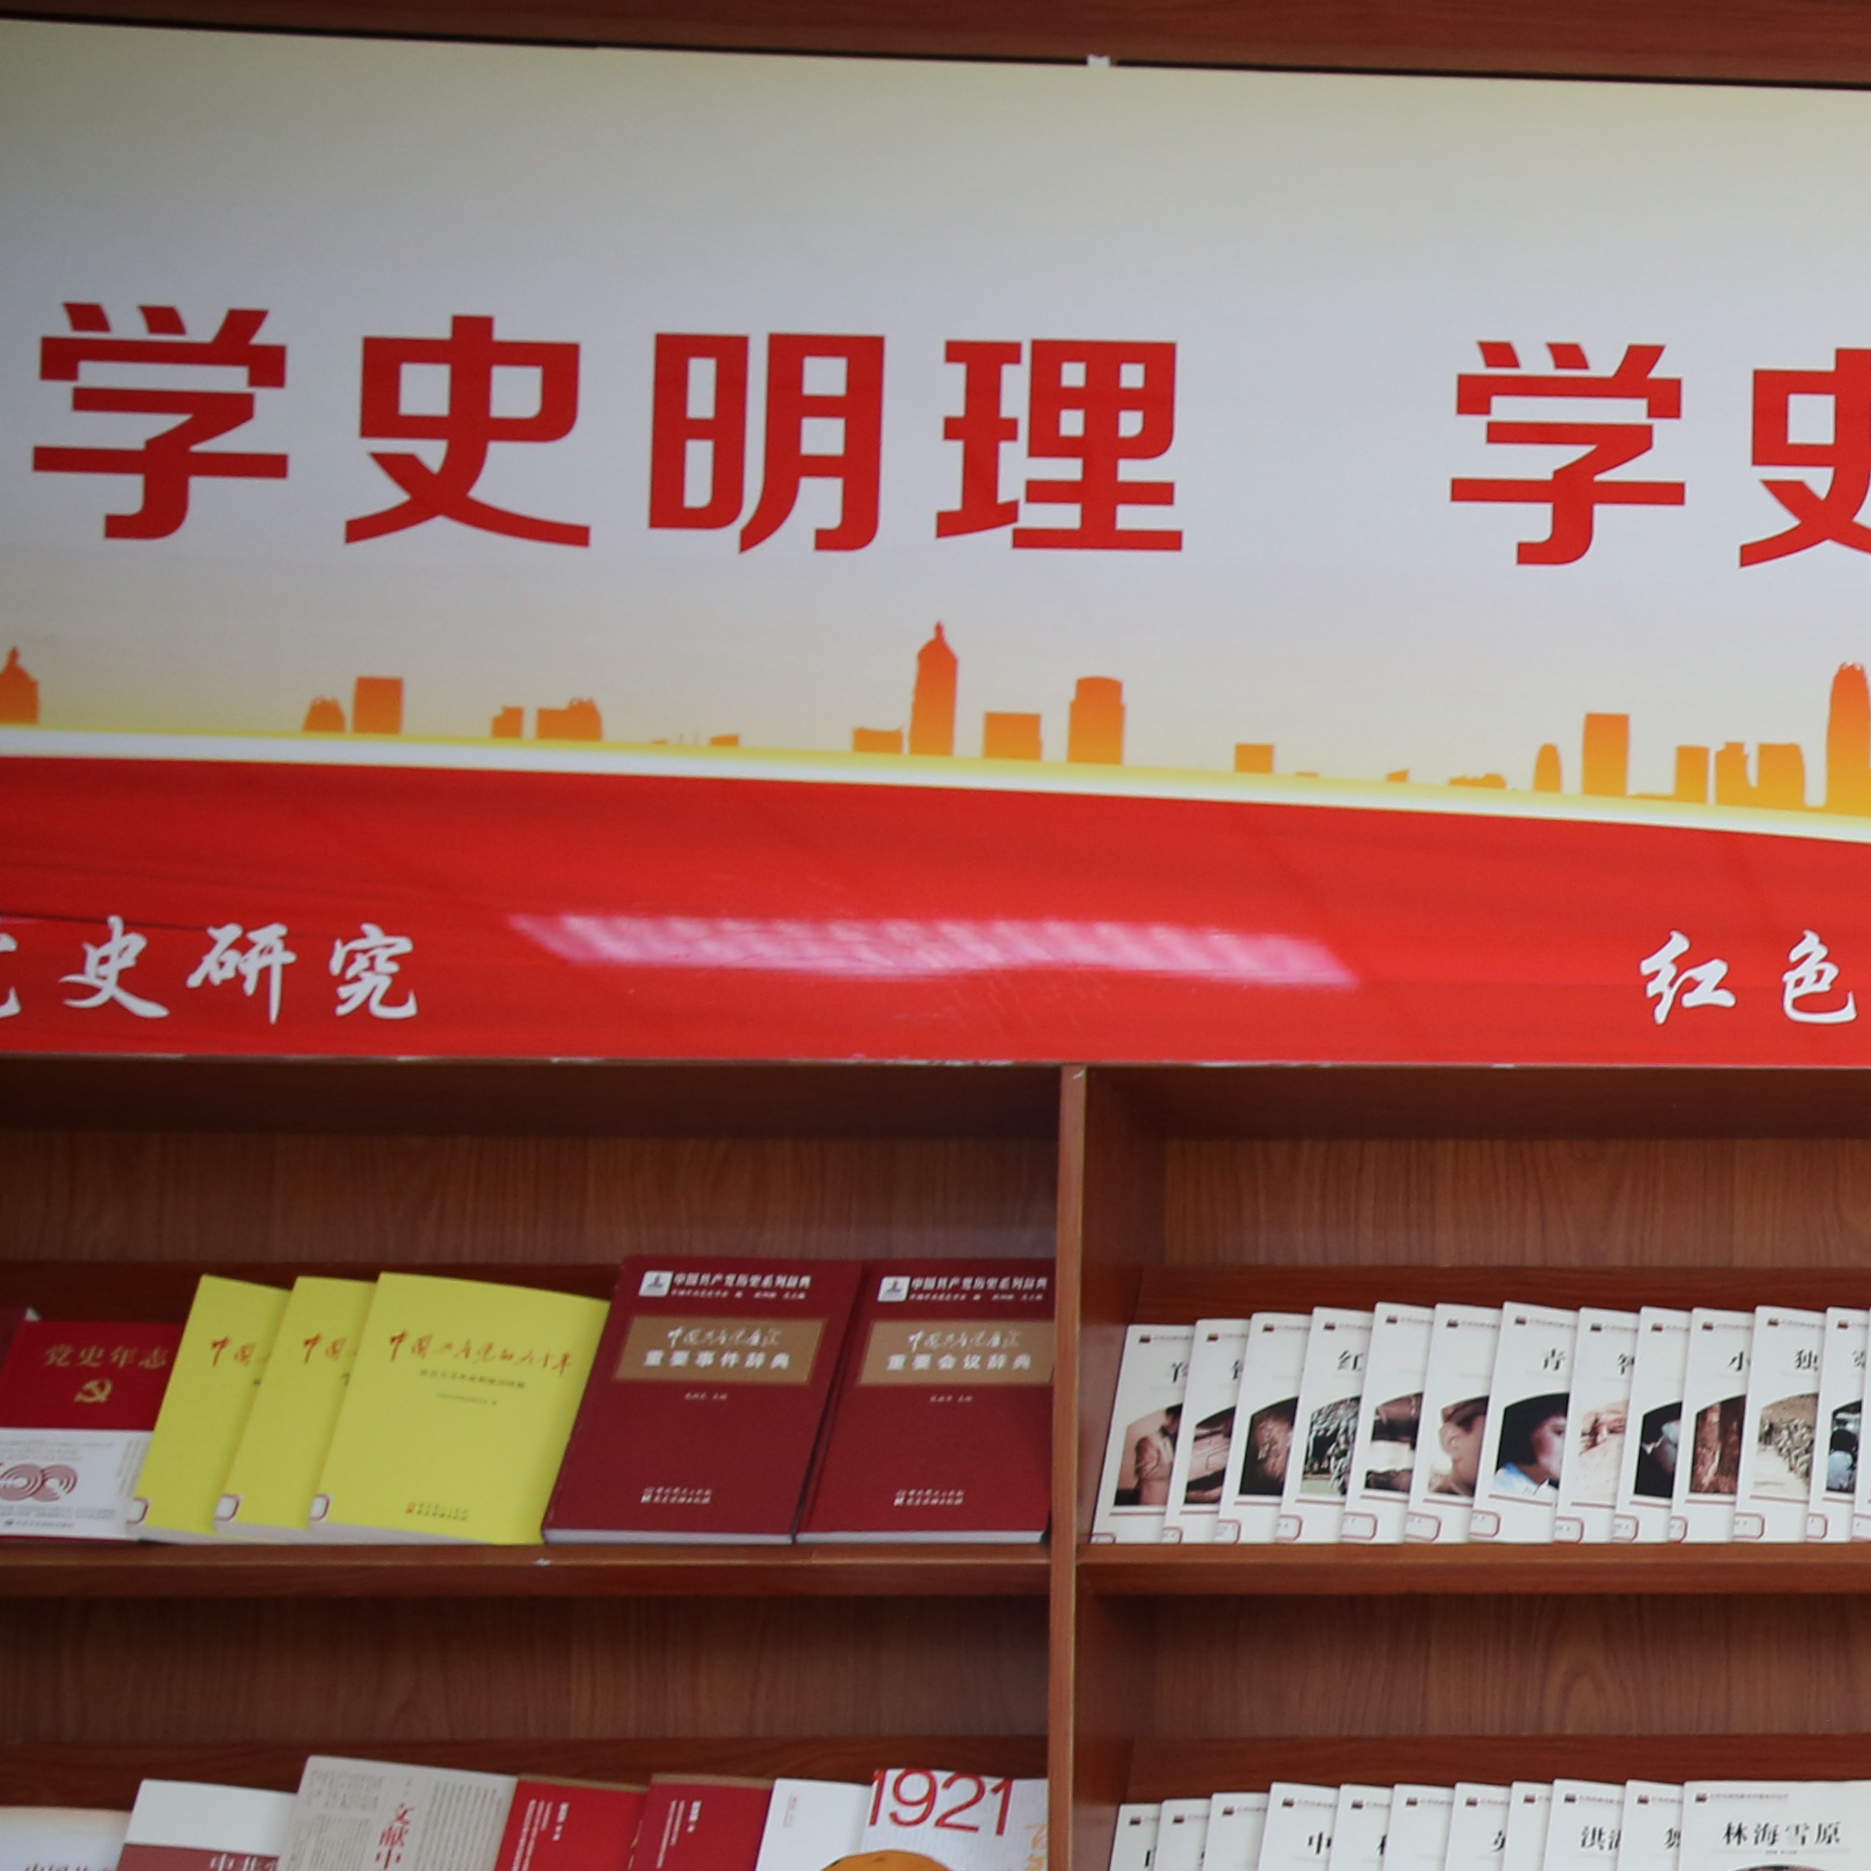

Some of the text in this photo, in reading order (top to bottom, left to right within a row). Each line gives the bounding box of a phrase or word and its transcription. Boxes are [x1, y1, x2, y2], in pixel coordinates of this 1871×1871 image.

[32, 301, 1185, 554] 学史明理
[643, 1349, 792, 1370] 重要事件辞典
[886, 1353, 1033, 1372] 重要会议辞典
[869, 1768, 1014, 1836] 1921
[1723, 1820, 1842, 1847] 林海雪原
